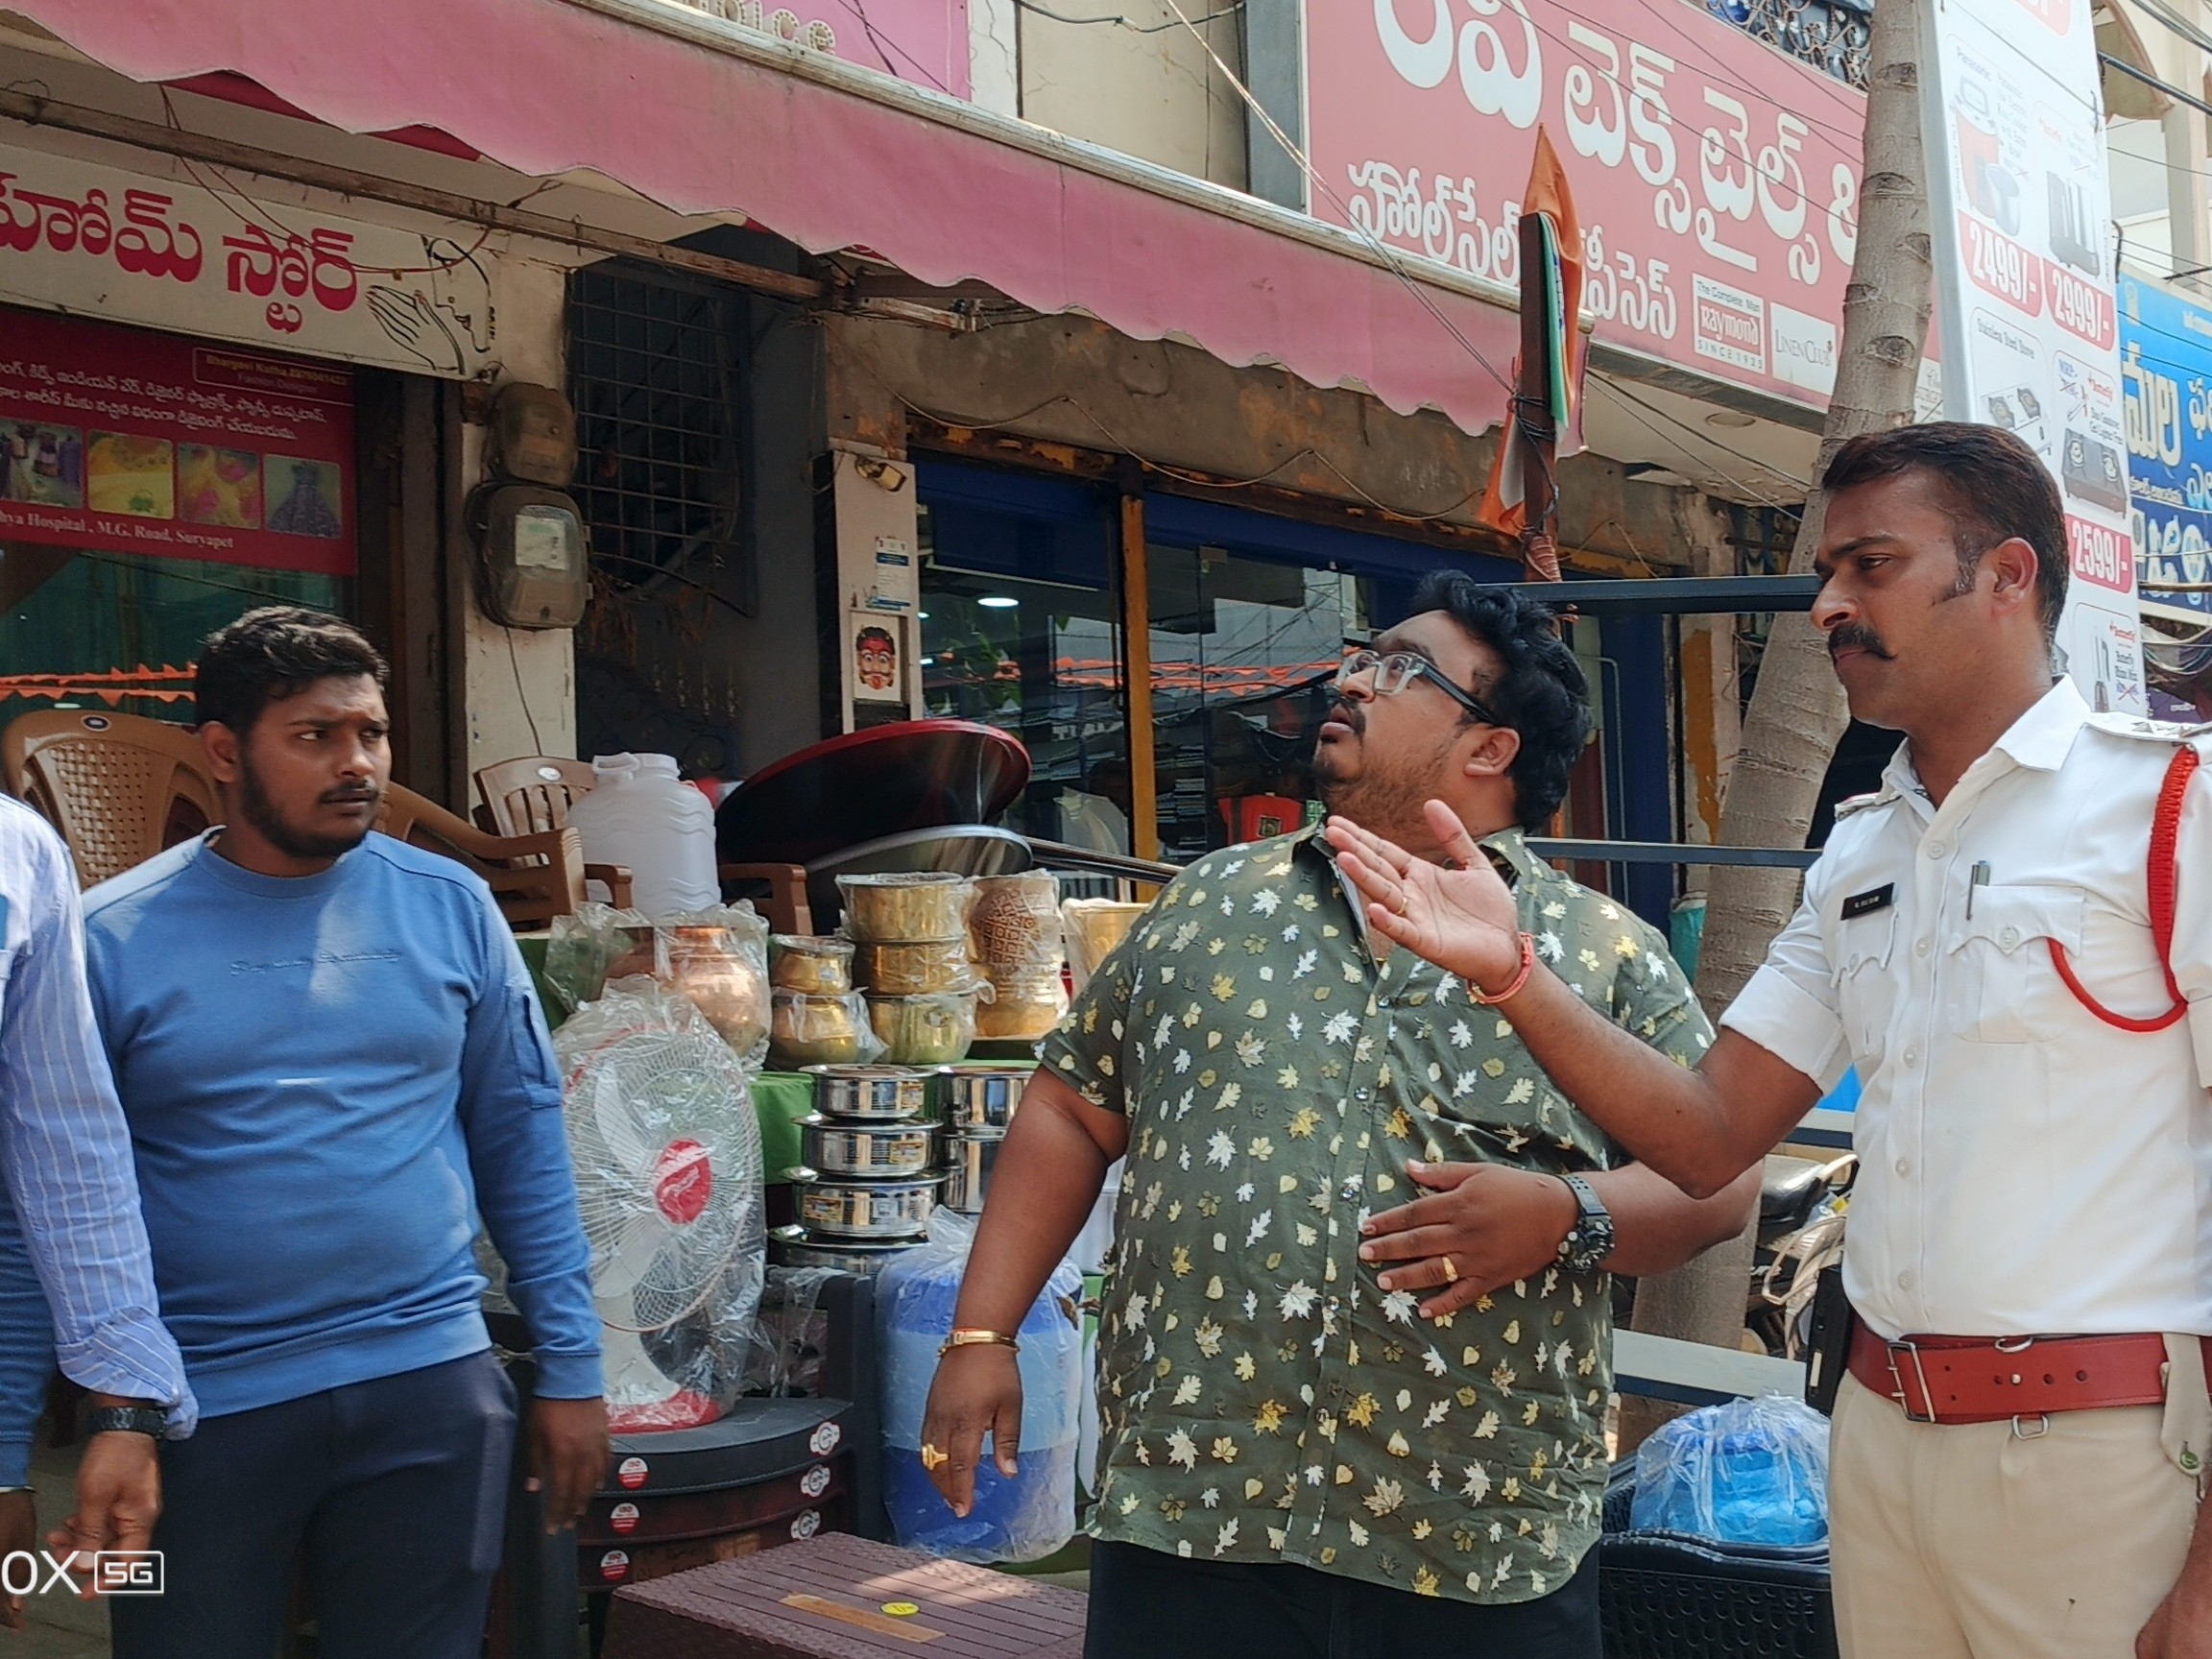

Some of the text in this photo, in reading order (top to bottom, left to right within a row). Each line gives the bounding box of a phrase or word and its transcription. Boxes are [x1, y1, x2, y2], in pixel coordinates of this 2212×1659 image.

[1969, 221, 2037, 304] 2499/-
[2052, 269, 2110, 343] 2999/-
[2072, 525, 2128, 586] 2599/-
